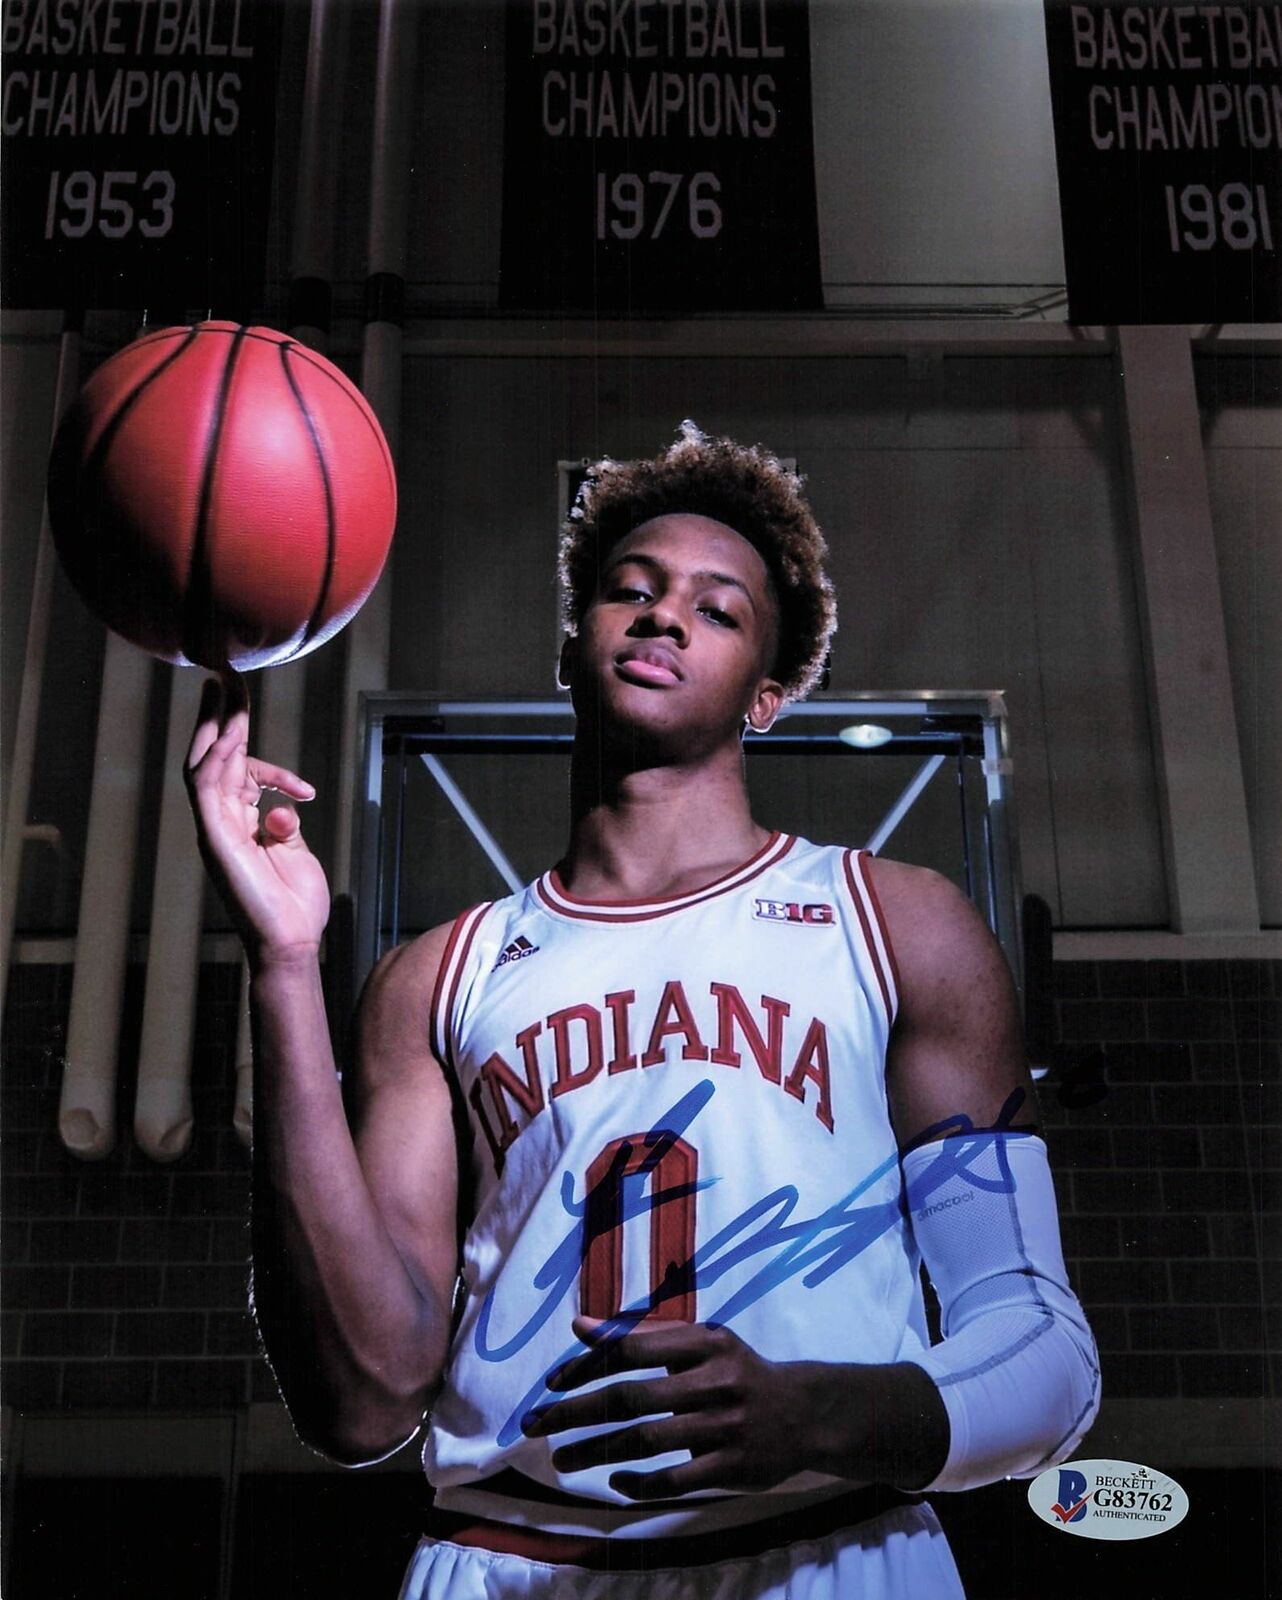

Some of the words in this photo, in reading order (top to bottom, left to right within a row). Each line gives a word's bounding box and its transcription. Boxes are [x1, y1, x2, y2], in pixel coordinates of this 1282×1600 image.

[2, 0, 254, 58] BASKETBALL
[532, 0, 785, 58] BASKETBALL
[2, 67, 243, 137] CHAMPIONS
[541, 69, 778, 139] CHAMPIONS
[43, 169, 177, 241] 1953
[596, 170, 724, 241] 1976
[1164, 181, 1274, 253] 1981
[468, 979, 834, 1181] INDIANA
